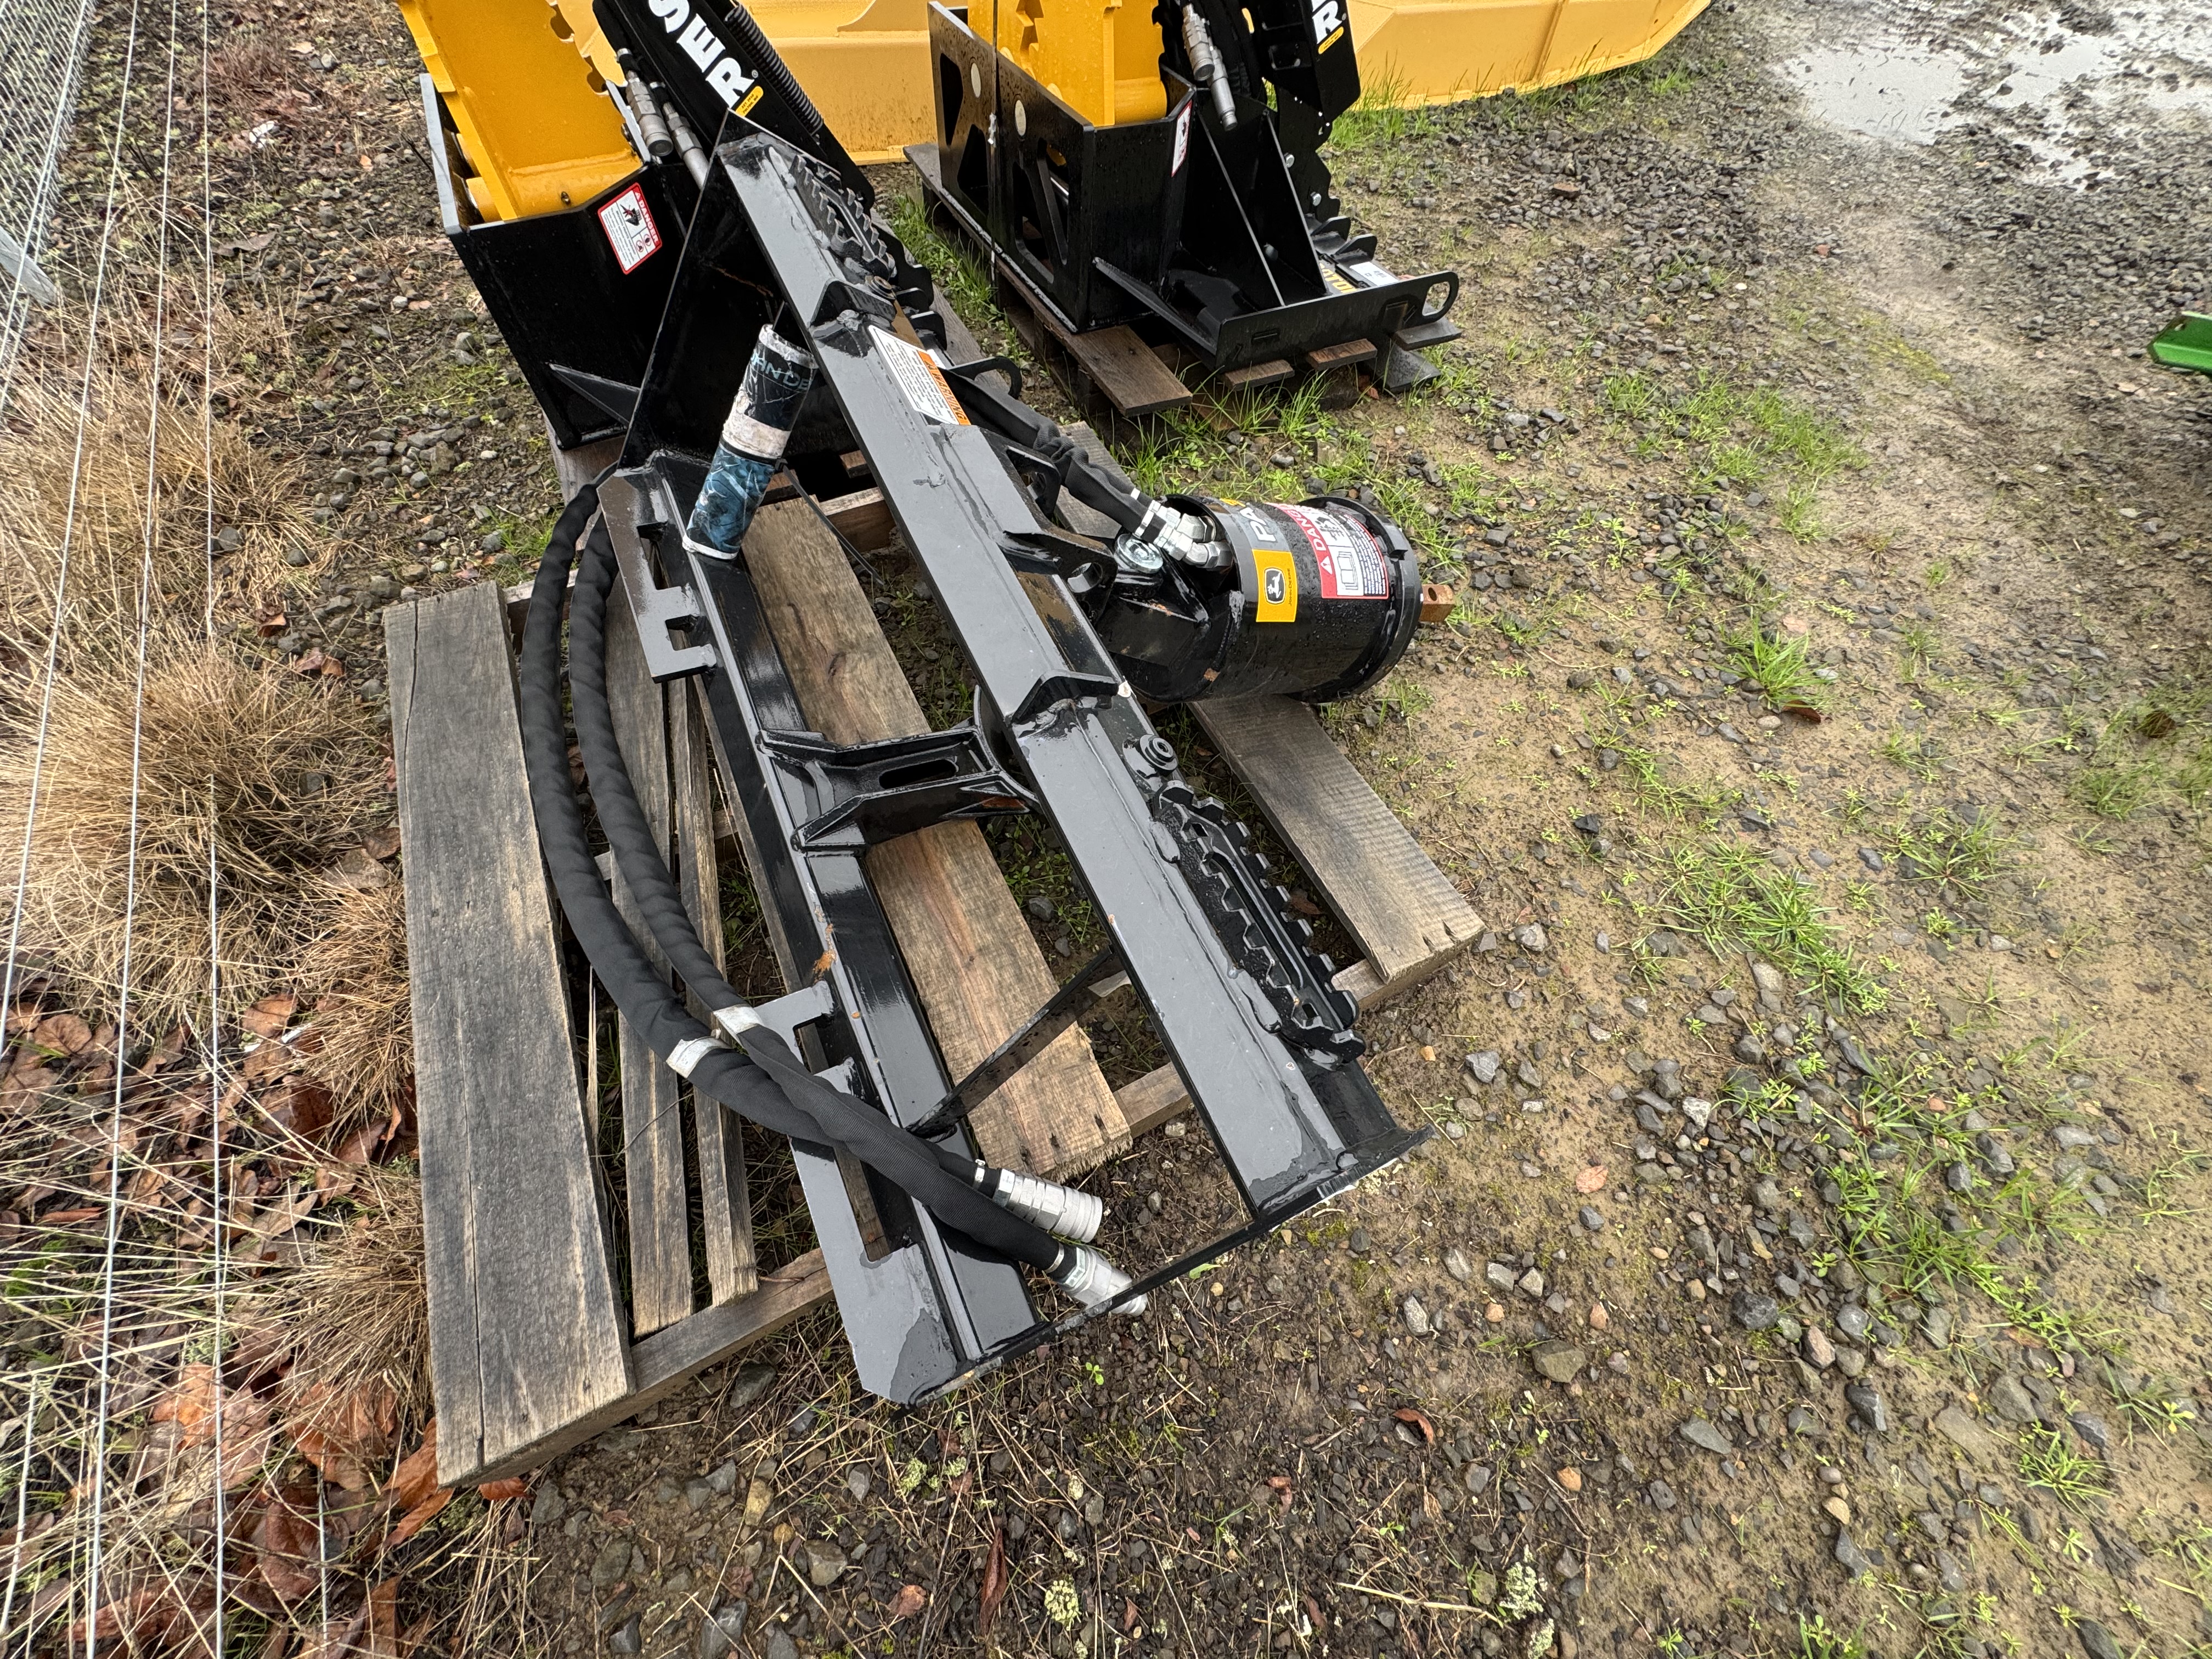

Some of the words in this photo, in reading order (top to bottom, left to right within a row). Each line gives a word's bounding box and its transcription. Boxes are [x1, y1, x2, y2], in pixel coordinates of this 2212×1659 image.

[639, 200, 659, 244] DANGER
[1319, 263, 1357, 294] ATO
[932, 373, 967, 420] WARNING
[1279, 505, 1327, 551] DANG
